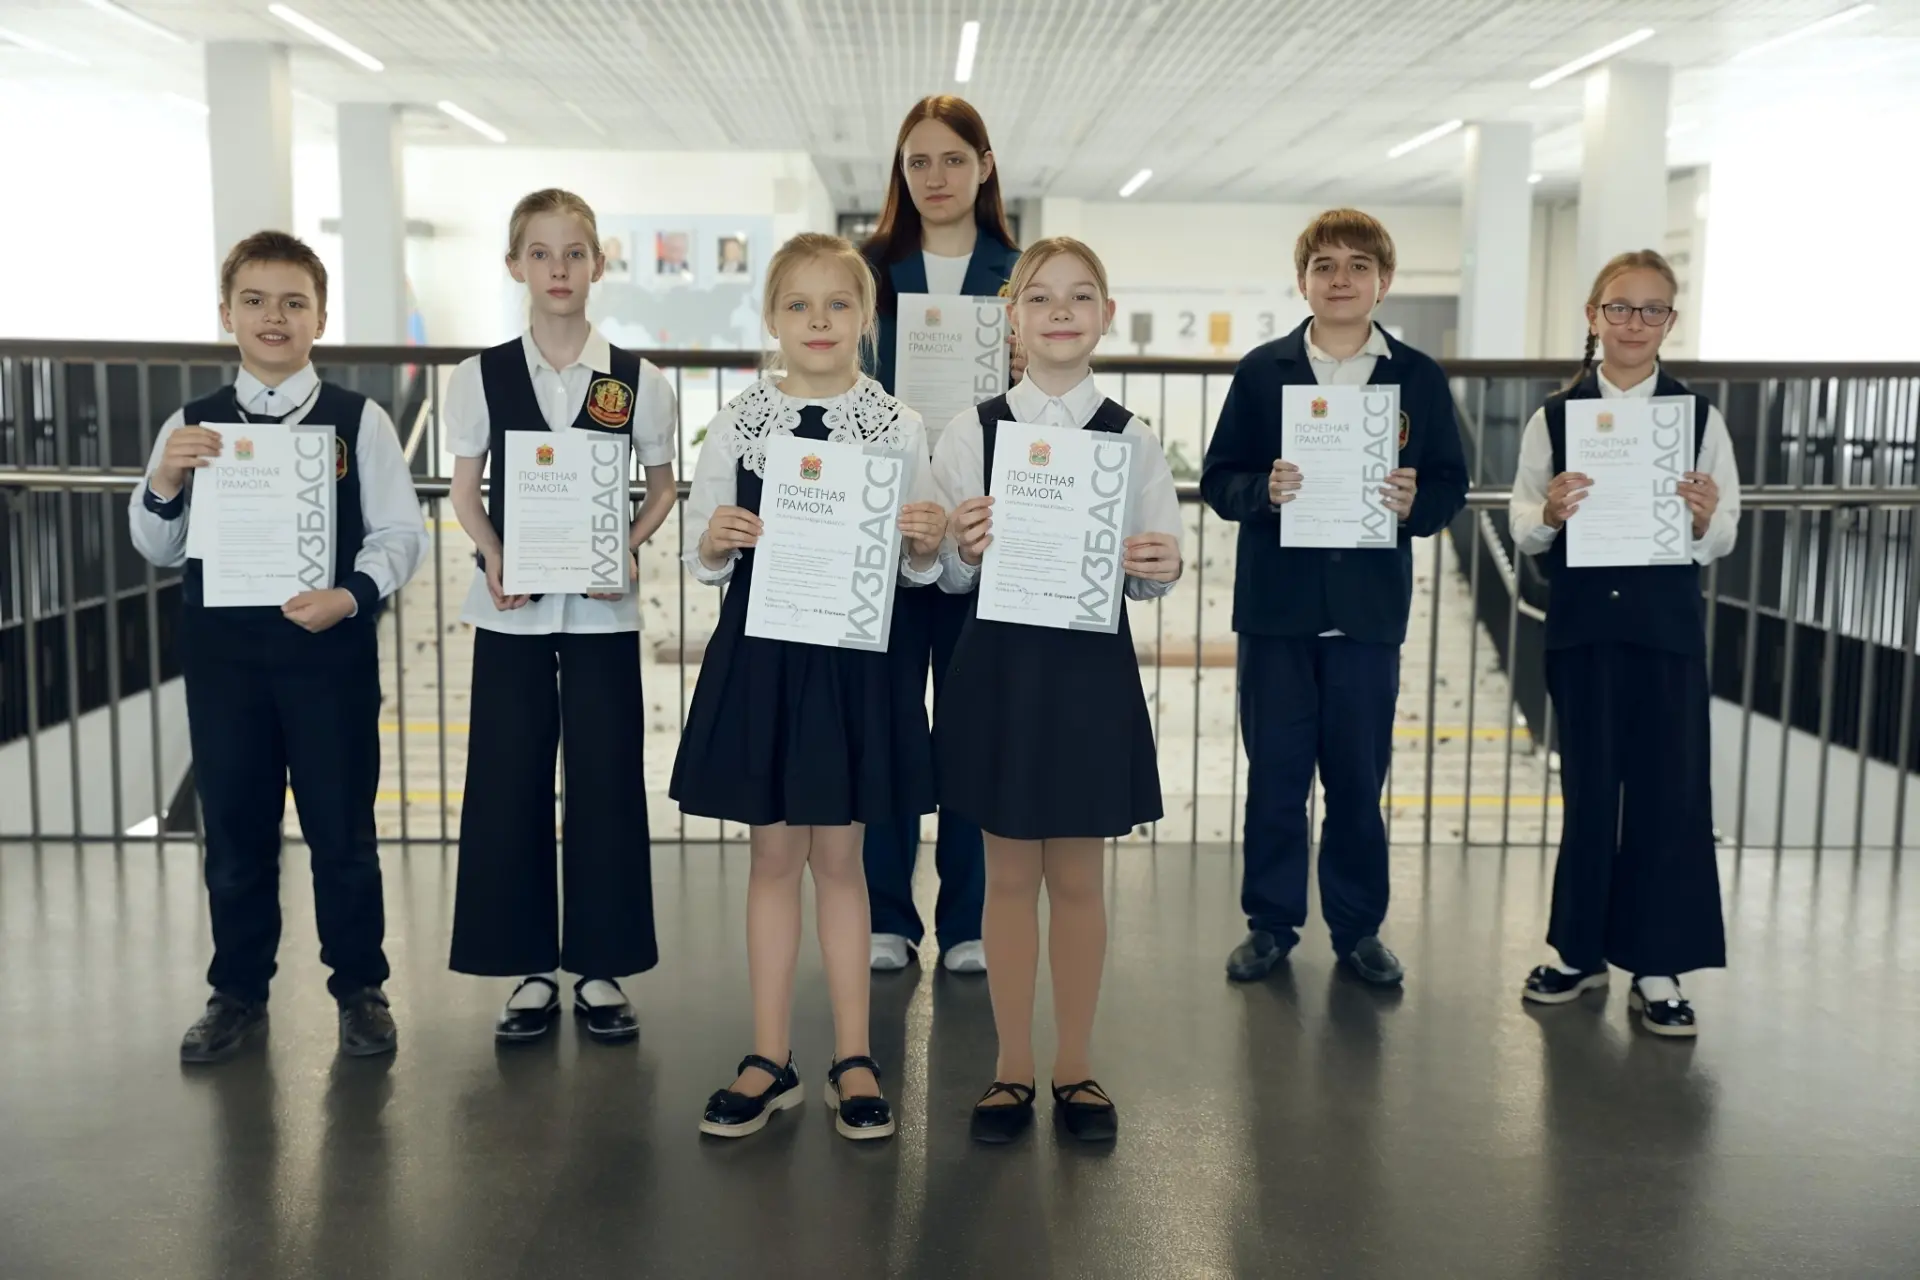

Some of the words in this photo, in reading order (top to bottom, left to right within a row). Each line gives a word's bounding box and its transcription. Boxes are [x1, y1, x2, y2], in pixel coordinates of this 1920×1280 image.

[1178, 311, 1196, 338] 2
[1257, 312, 1275, 338] 3
[908, 331, 962, 342] ПОЧЕТНАЯ
[908, 343, 954, 353] ГРАМОТА
[1294, 423, 1350, 434] ПОЧЕТНАЯ
[1294, 435, 1341, 445] ГРАМОТА
[1579, 437, 1638, 449] ПОЧЕТНАЯ
[1579, 450, 1629, 460] ГРАМОТА
[215, 466, 280, 478] ПОЧЕТНАЯ
[518, 470, 578, 481] ПОЧЕТНАЯ
[1006, 469, 1075, 489] ПОЧЕТНАЯ
[215, 479, 271, 490] ГРАМОТА
[518, 482, 569, 494] ГРАМОТА
[1653, 406, 1681, 557] КУЗБАСС
[778, 483, 846, 502] ПОЧЕТНАЯ
[1005, 483, 1063, 501] ГРАМОТА
[775, 497, 834, 516] ГРАМОТА
[591, 443, 619, 586] КУЗБАСС
[1075, 443, 1127, 623] КУЗБАСС
[845, 459, 898, 641] КУЗБАСС
